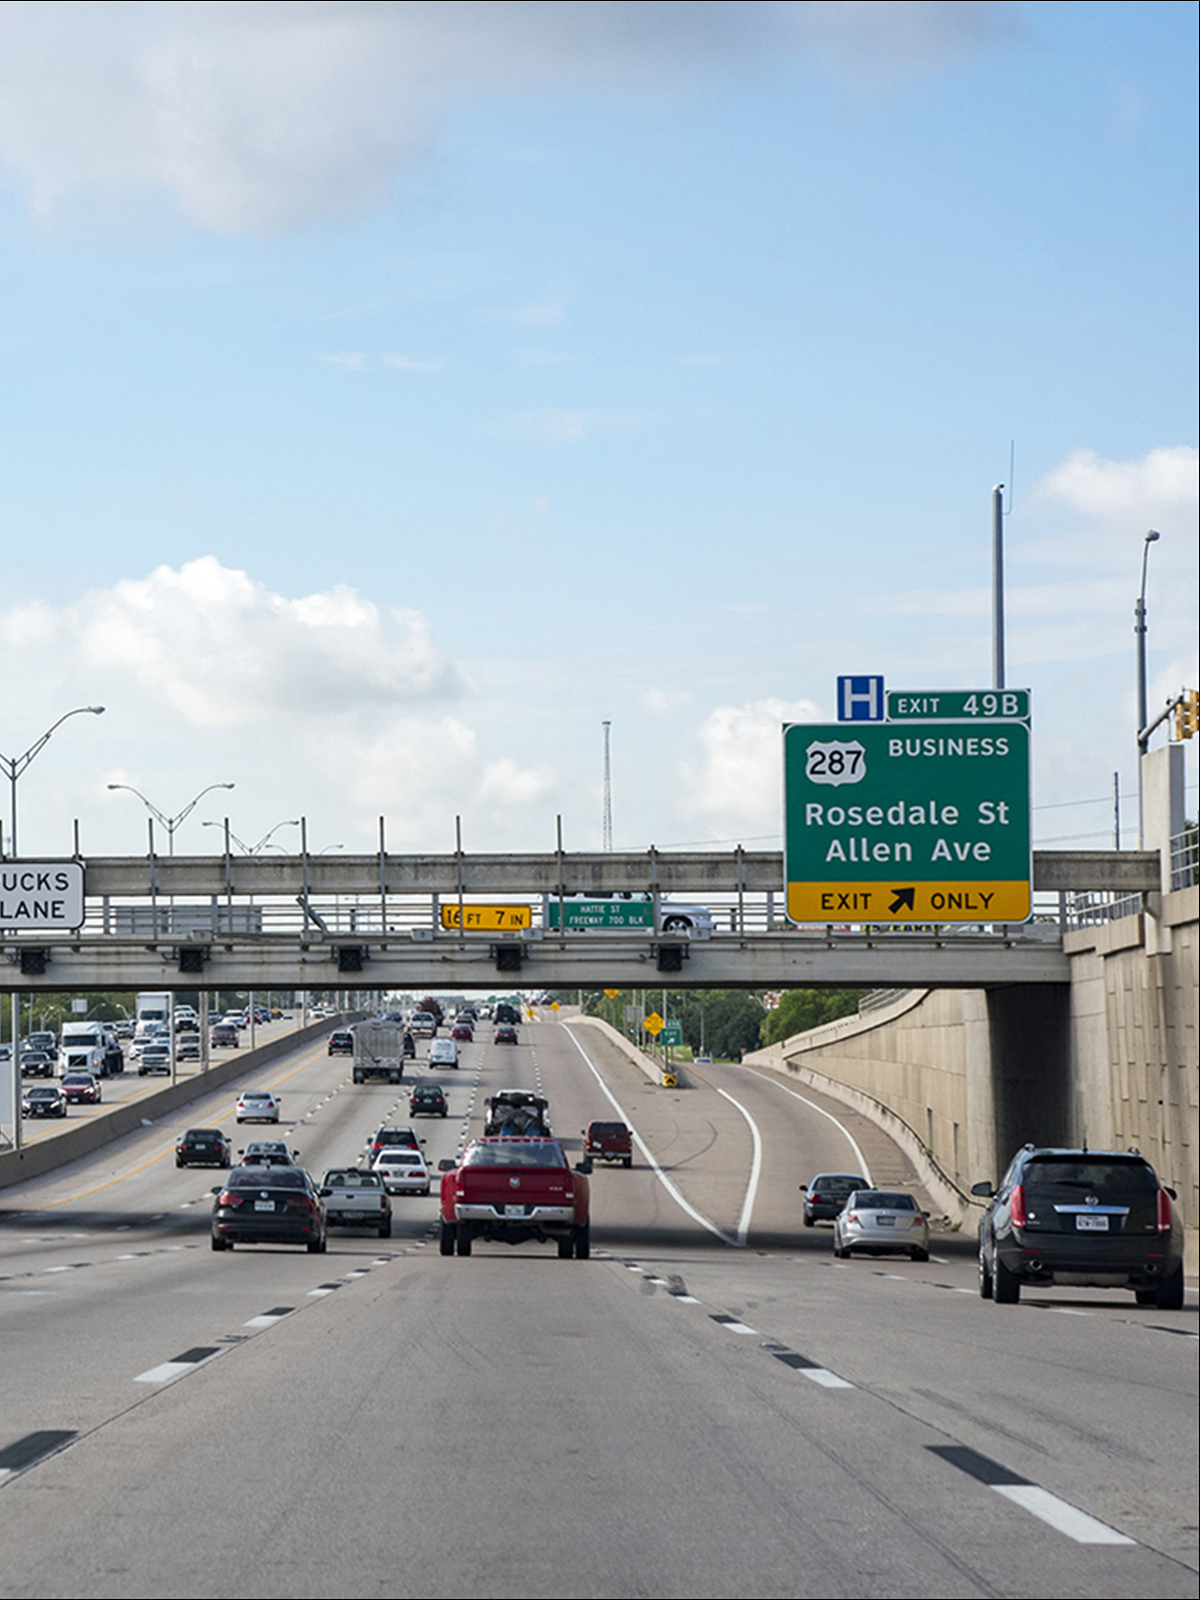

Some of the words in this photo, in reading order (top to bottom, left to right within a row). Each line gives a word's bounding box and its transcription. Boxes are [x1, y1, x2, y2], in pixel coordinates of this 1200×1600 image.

[843, 679, 877, 718] H
[897, 698, 940, 714] EXIT
[963, 694, 1019, 716] 49B
[888, 738, 1010, 757] BUSINESS
[808, 750, 863, 776] 287
[805, 801, 960, 826] Rosedale
[977, 801, 1010, 825] St
[825, 837, 913, 862] Allen
[930, 838, 992, 862] Ave
[0, 901, 65, 919] LANE
[580, 905, 606, 914] HATTIE
[610, 905, 620, 914] ST
[820, 893, 873, 911] EXIT
[930, 892, 995, 911] ONLY
[467, 913, 482, 925] FT
[495, 910, 506, 925] 7
[510, 914, 524, 926] IN
[569, 916, 604, 925] FREEWAY
[609, 916, 625, 925] 700
[628, 916, 645, 925] BLK
